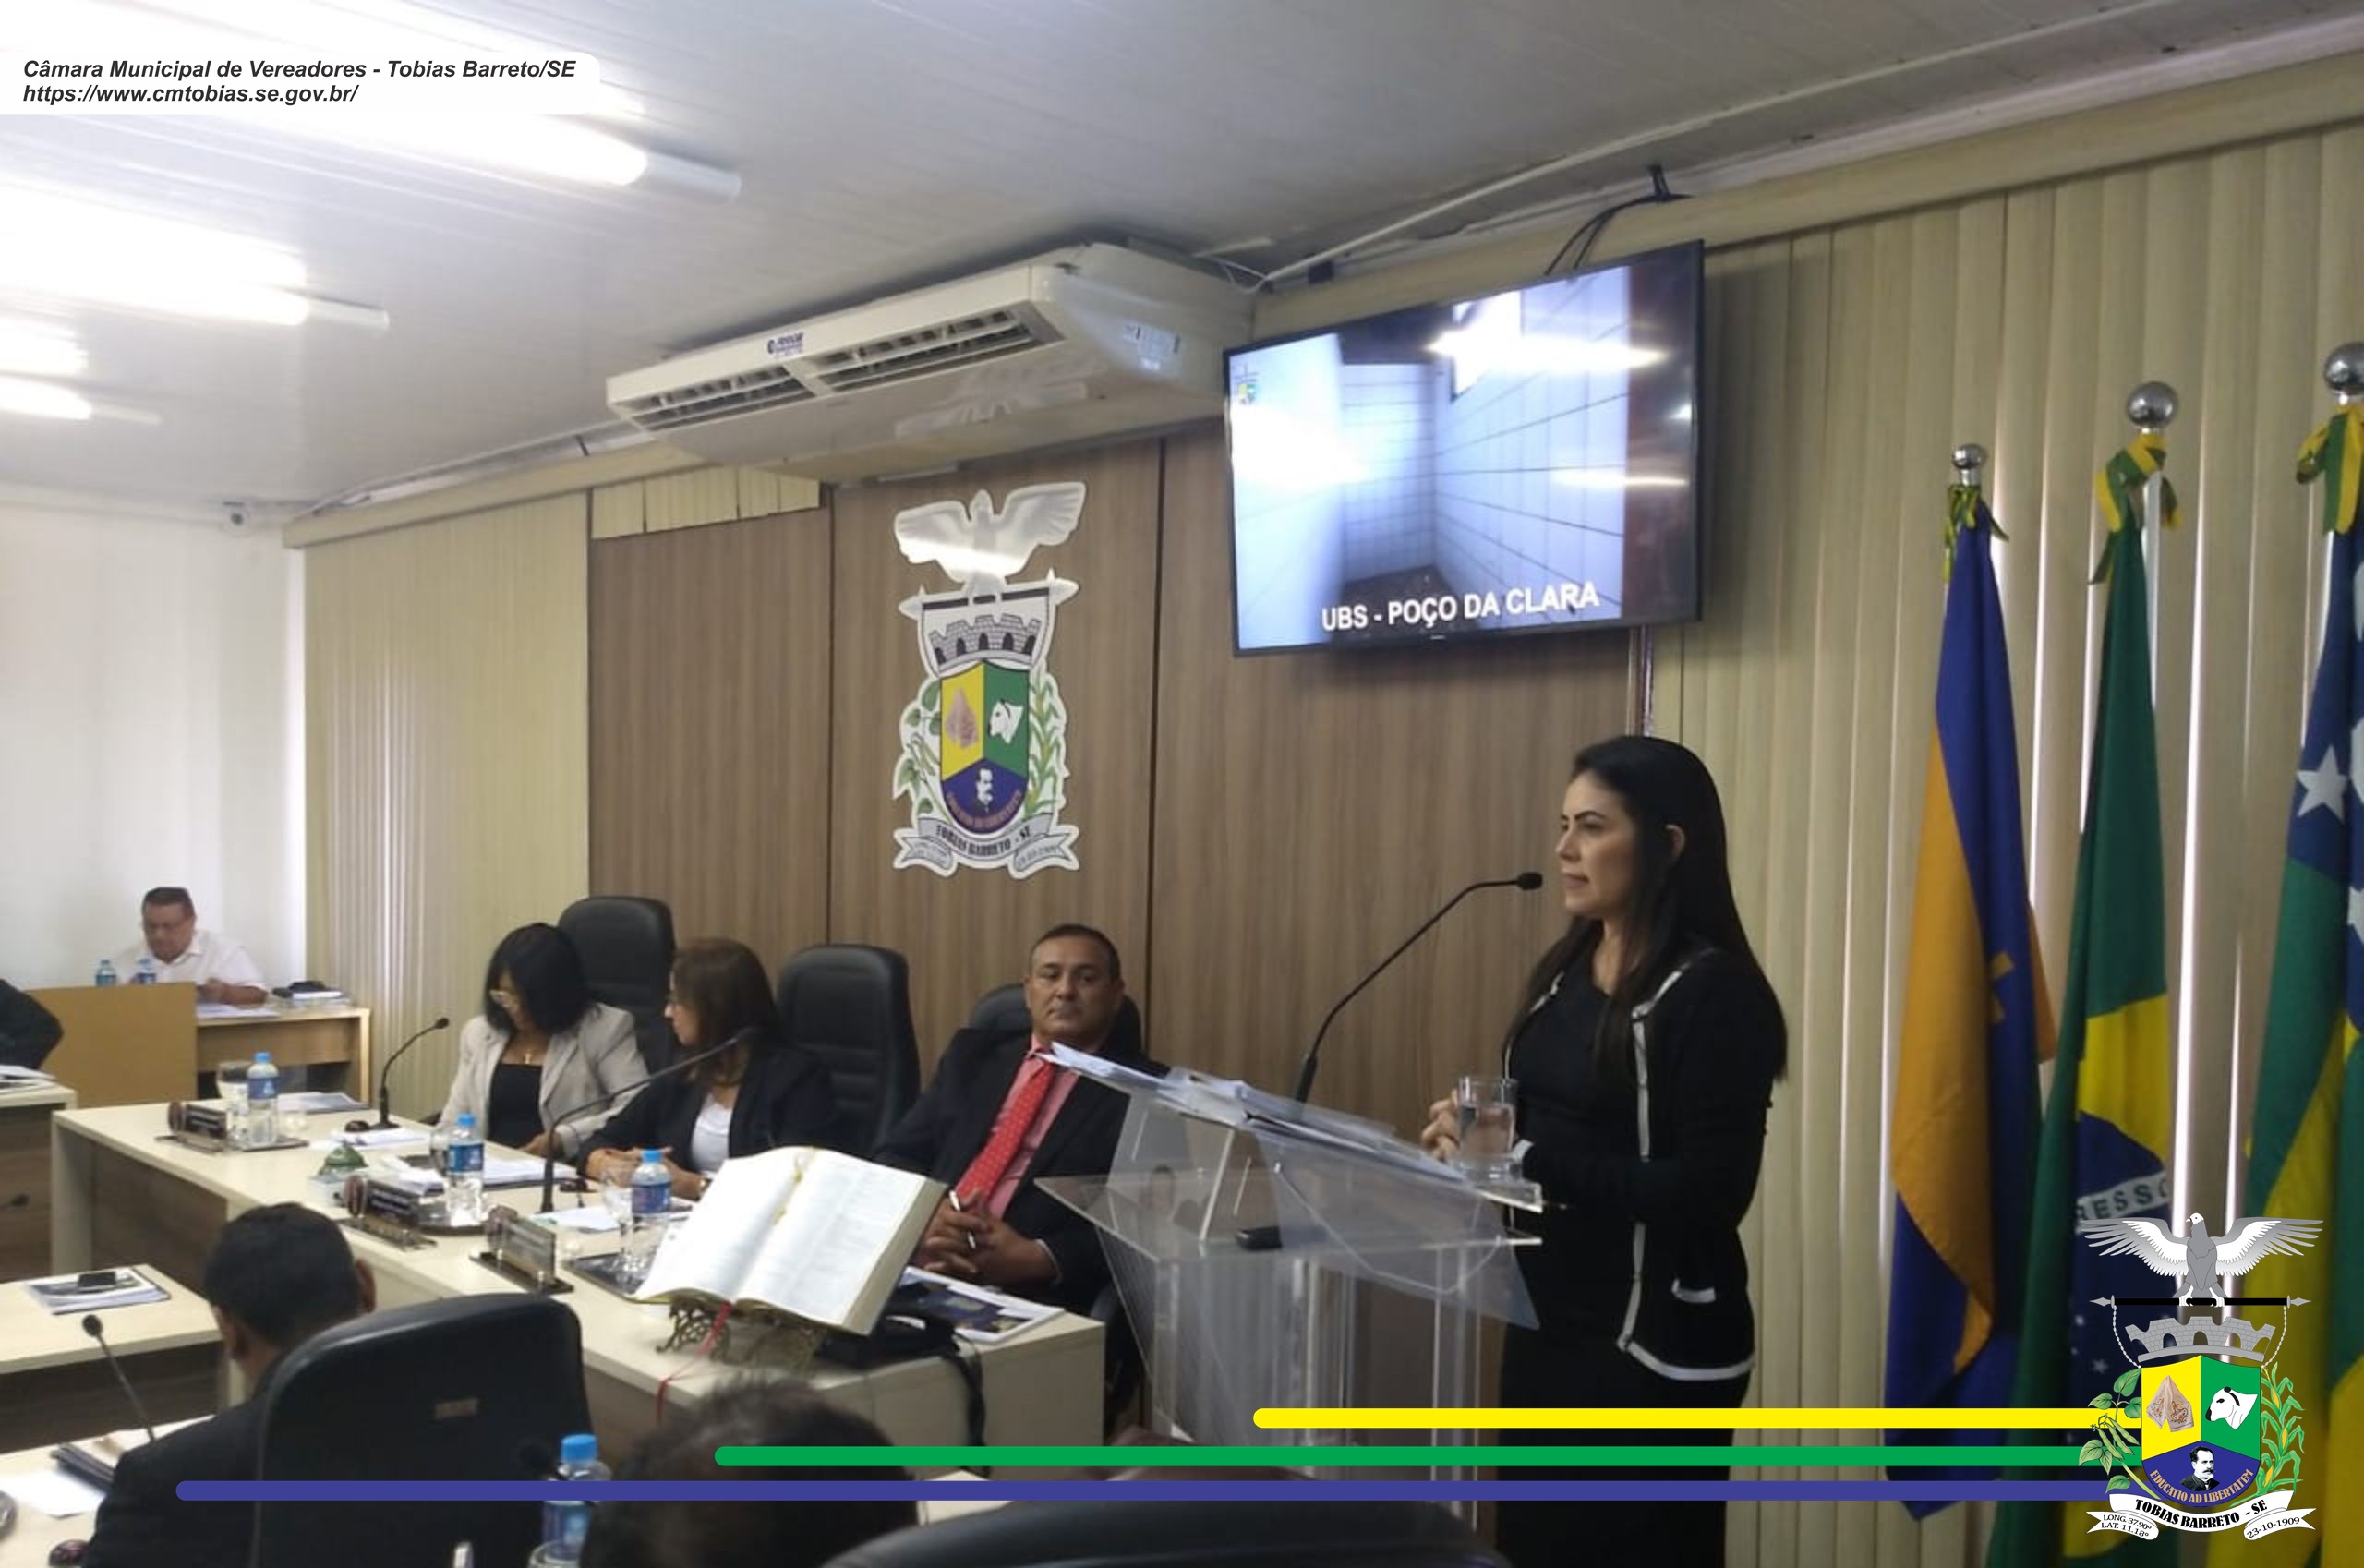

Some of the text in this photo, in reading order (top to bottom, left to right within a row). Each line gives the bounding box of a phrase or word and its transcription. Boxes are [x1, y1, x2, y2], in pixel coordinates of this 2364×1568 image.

[1322, 605, 1368, 631] UBS
[1389, 596, 1457, 628] POÇO
[1464, 592, 1500, 619] DA
[1506, 581, 1600, 613] CLARA
